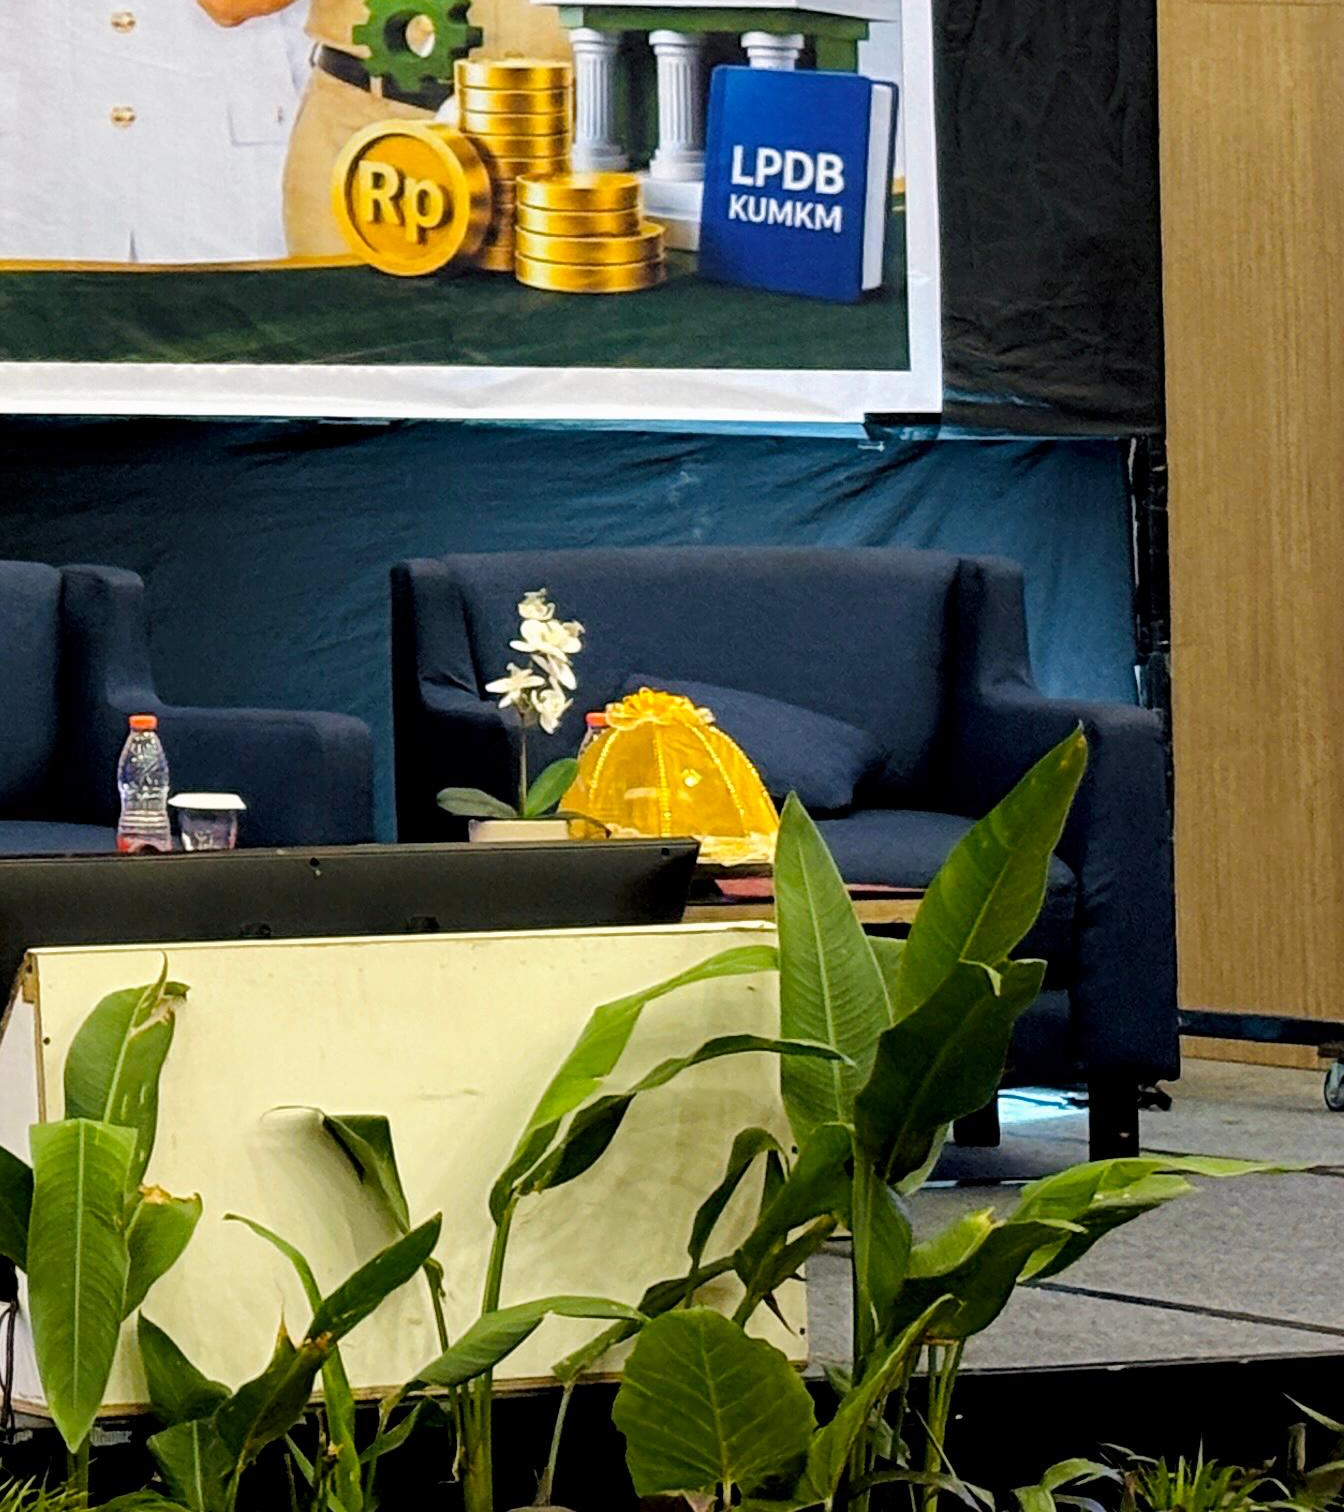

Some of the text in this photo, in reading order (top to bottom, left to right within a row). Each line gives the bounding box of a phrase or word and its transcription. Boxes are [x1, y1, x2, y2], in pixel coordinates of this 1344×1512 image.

[732, 145, 844, 194] LPDB
[358, 159, 444, 243] Rp
[729, 194, 842, 232] KUMKM
